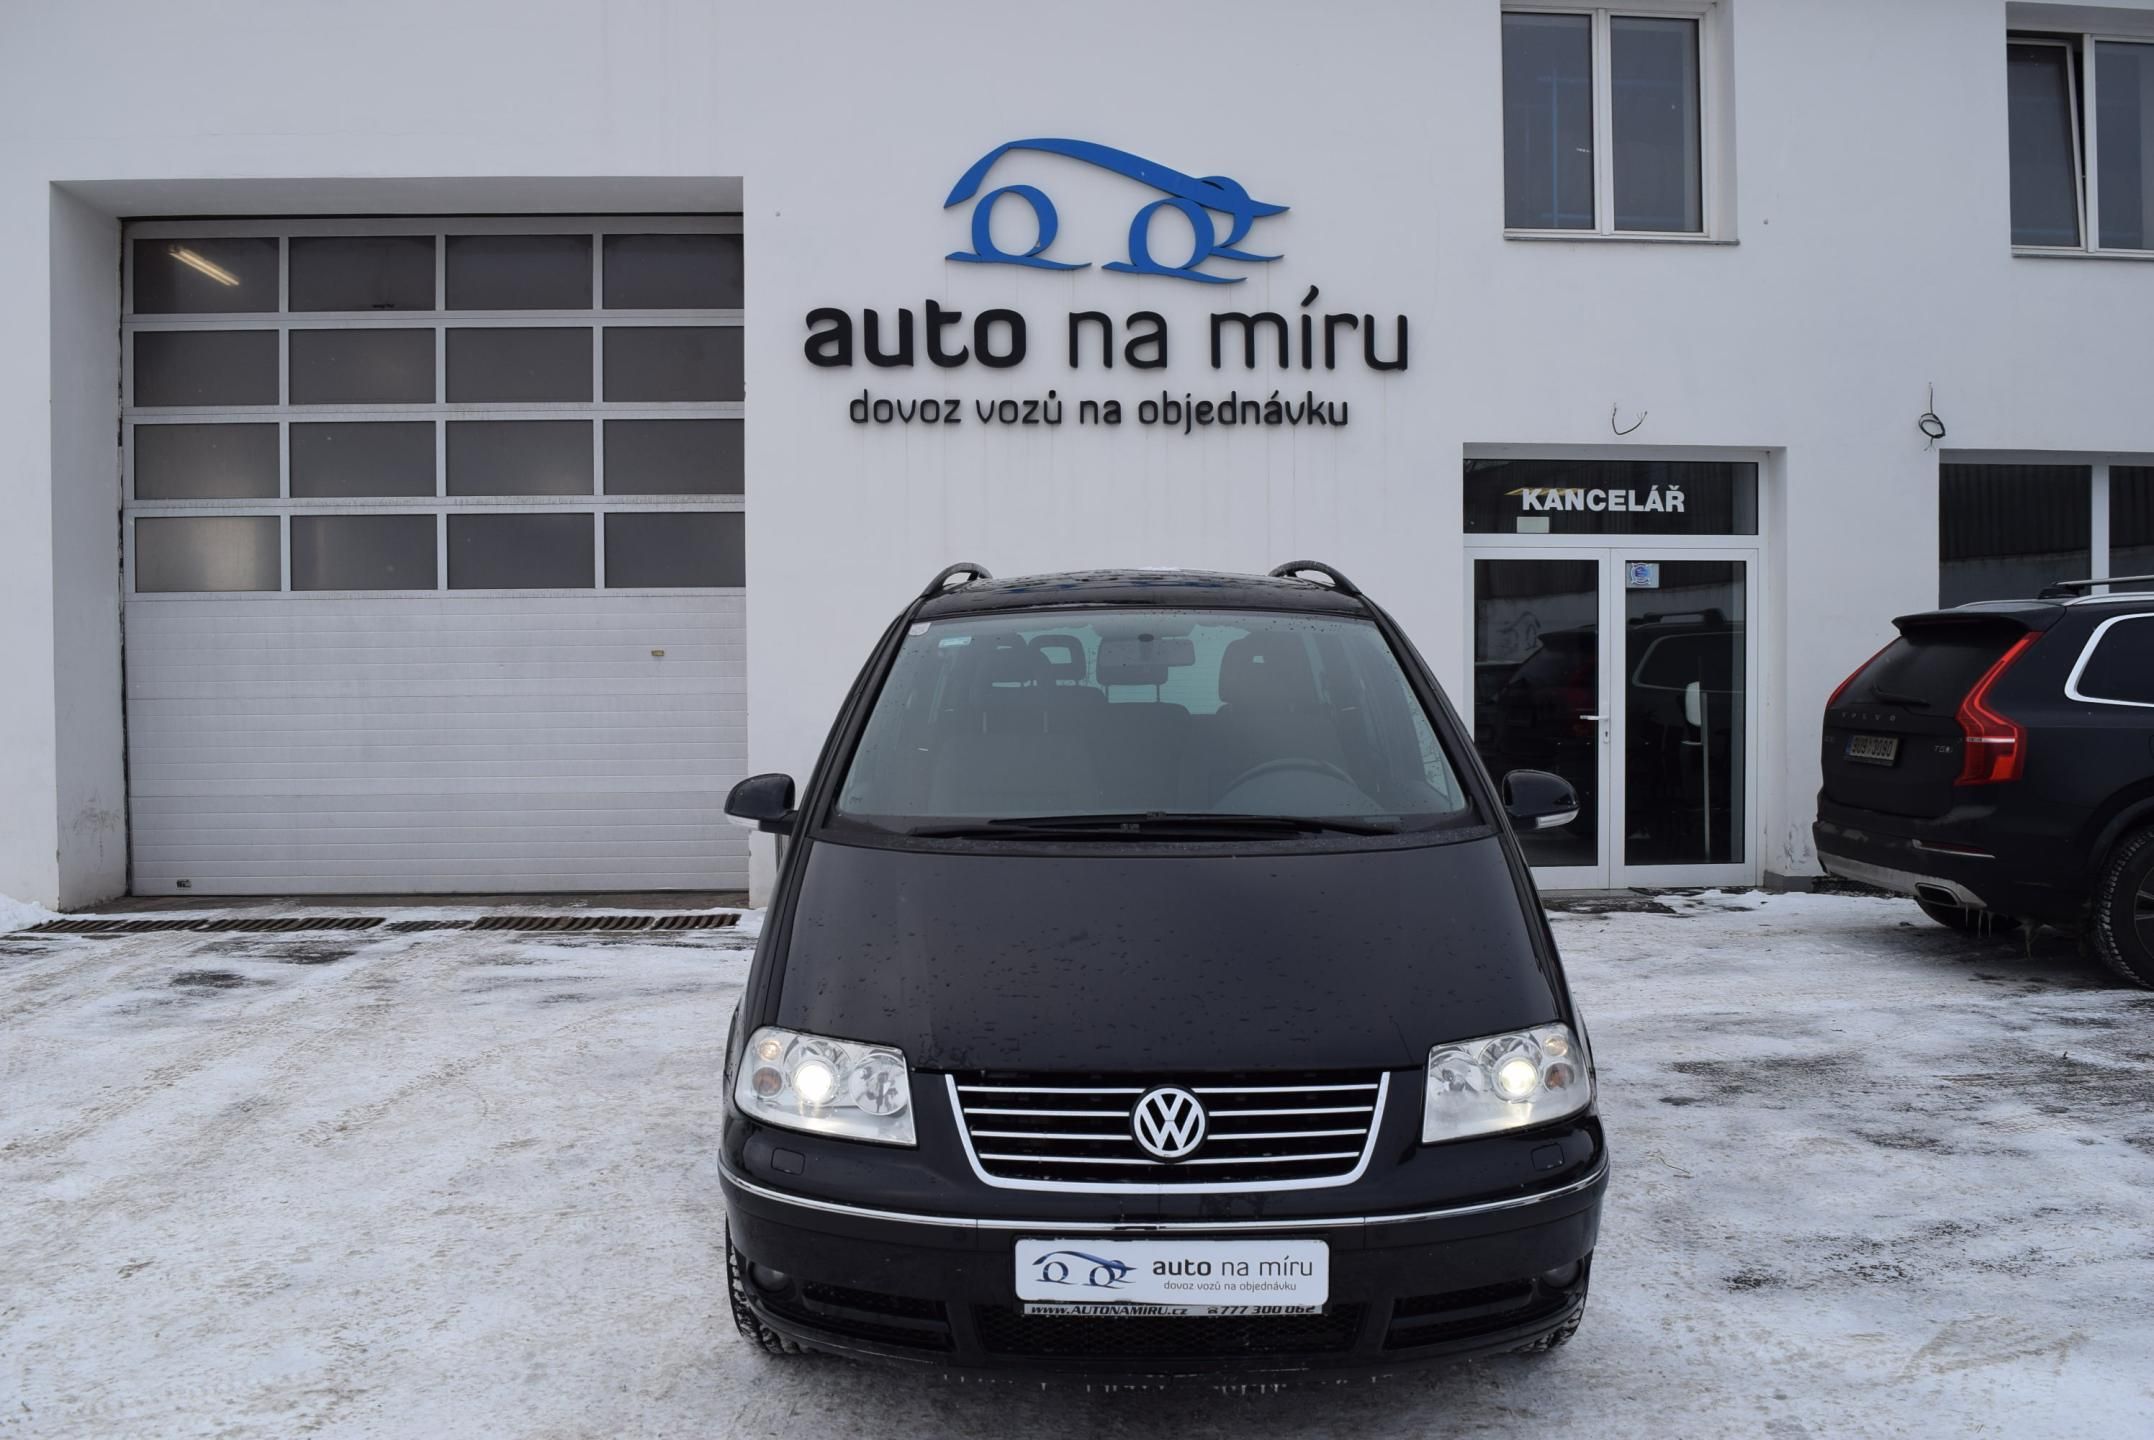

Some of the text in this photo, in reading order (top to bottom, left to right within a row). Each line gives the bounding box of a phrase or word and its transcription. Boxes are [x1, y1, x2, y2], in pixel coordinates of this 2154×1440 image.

[804, 285, 1408, 371] auto na míru
[849, 389, 1348, 435] dovoz vozů na objednávku
[1522, 485, 1685, 512] KANCELÁŘ
[1134, 1088, 1205, 1158] VW
[1153, 1256, 1313, 1276] auto na míru
[1164, 1280, 1297, 1292] dovoz vozů na objednávku
[1221, 1305, 1249, 1314] 777
[1252, 1305, 1282, 1314] 300
